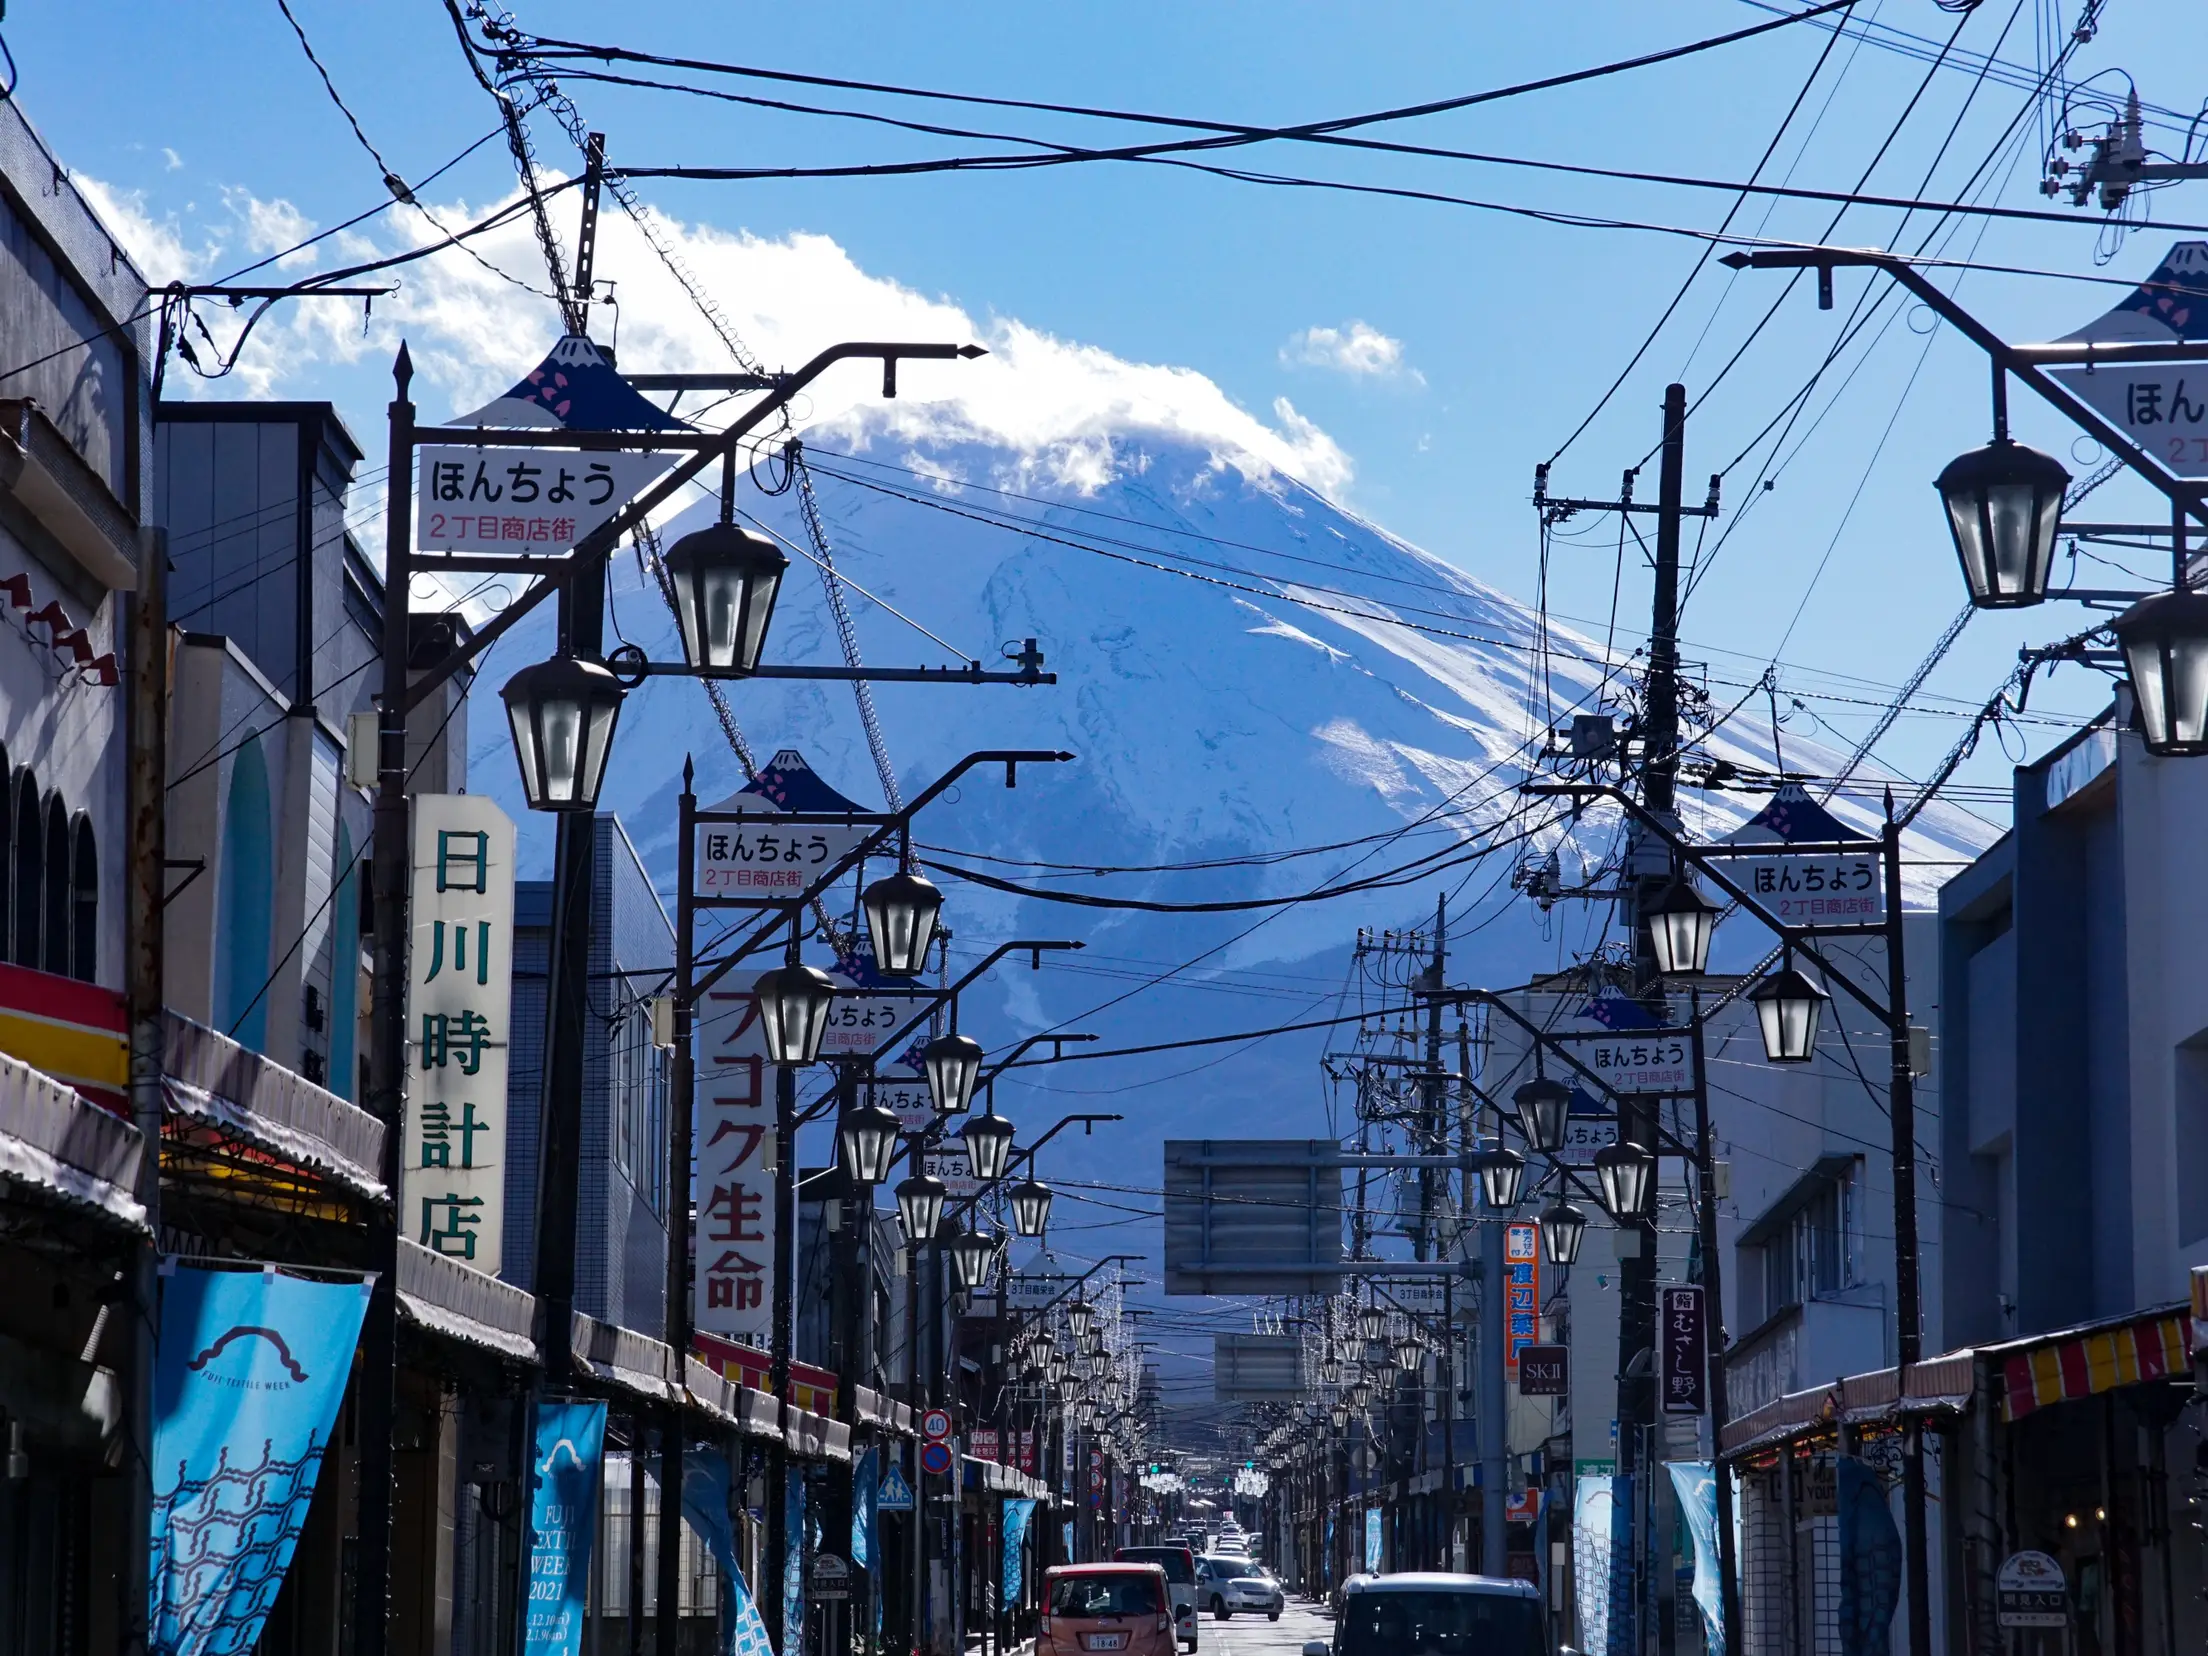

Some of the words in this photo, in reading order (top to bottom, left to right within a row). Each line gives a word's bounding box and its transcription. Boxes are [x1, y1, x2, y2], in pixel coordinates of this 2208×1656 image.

[2127, 379, 2205, 426] ほん
[432, 460, 615, 506] ほんちょう
[430, 514, 576, 543] 2丁目商店街
[706, 833, 828, 864] ほんちょう
[705, 868, 803, 888] 2丁目商店街
[1754, 863, 1873, 894] ほんちょう
[1779, 897, 1875, 917] 2丁目商店街
[420, 829, 491, 1261] 日川時計店
[1595, 1043, 1684, 1068] ほんちょう
[1614, 1070, 1686, 1085] 2丁目商店街
[703, 991, 767, 1311] フコク生命
[1671, 1312, 1697, 1398] むさし野
[264, 1381, 291, 1391] WEEK
[927, 1417, 945, 1432] 40
[528, 1581, 565, 1601] 2021
